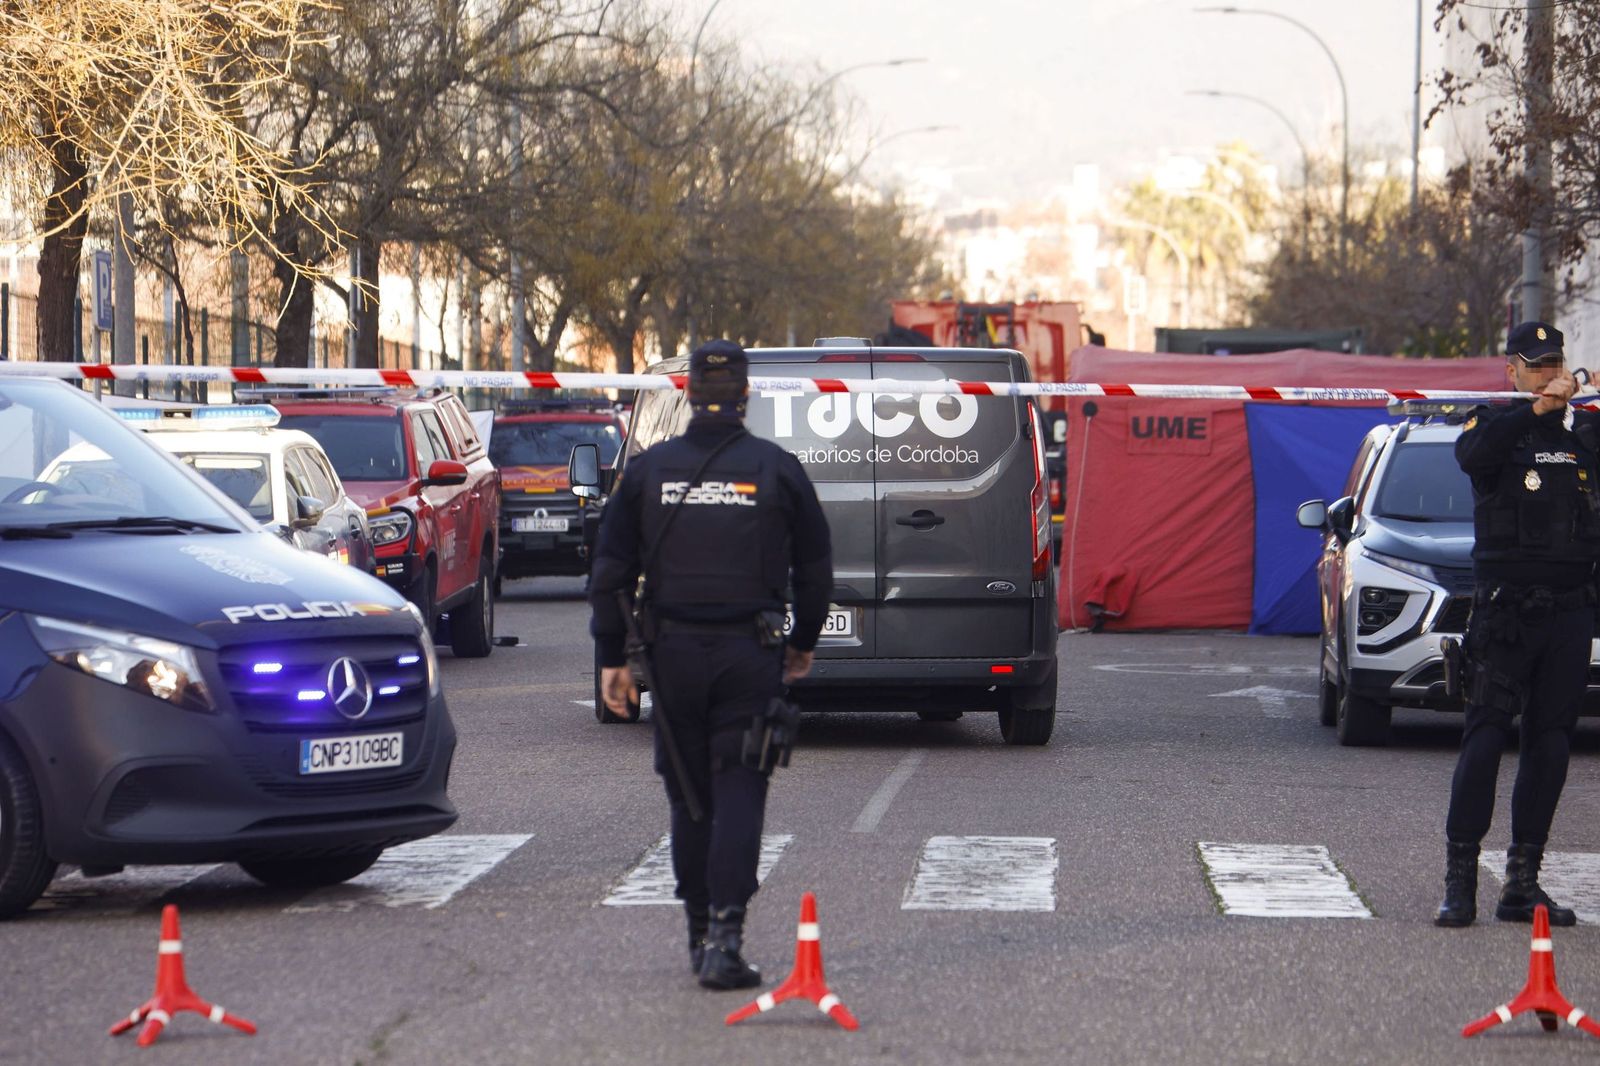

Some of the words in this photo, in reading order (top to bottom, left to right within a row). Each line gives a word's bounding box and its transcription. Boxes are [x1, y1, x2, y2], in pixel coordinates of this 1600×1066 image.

[99, 261, 109, 319] P
[463, 377, 478, 386] NO
[481, 377, 513, 386] PASAR
[752, 381, 767, 390] NO
[770, 381, 802, 390] PASAR
[1038, 383, 1052, 392] NO
[1055, 383, 1088, 392] PASAR
[1131, 416, 1208, 440] UME
[788, 445, 861, 464] atorios
[866, 445, 892, 464] de
[897, 444, 979, 464] Córdoba
[221, 602, 367, 624] POLICIA
[310, 737, 399, 768] CNP3109BC
